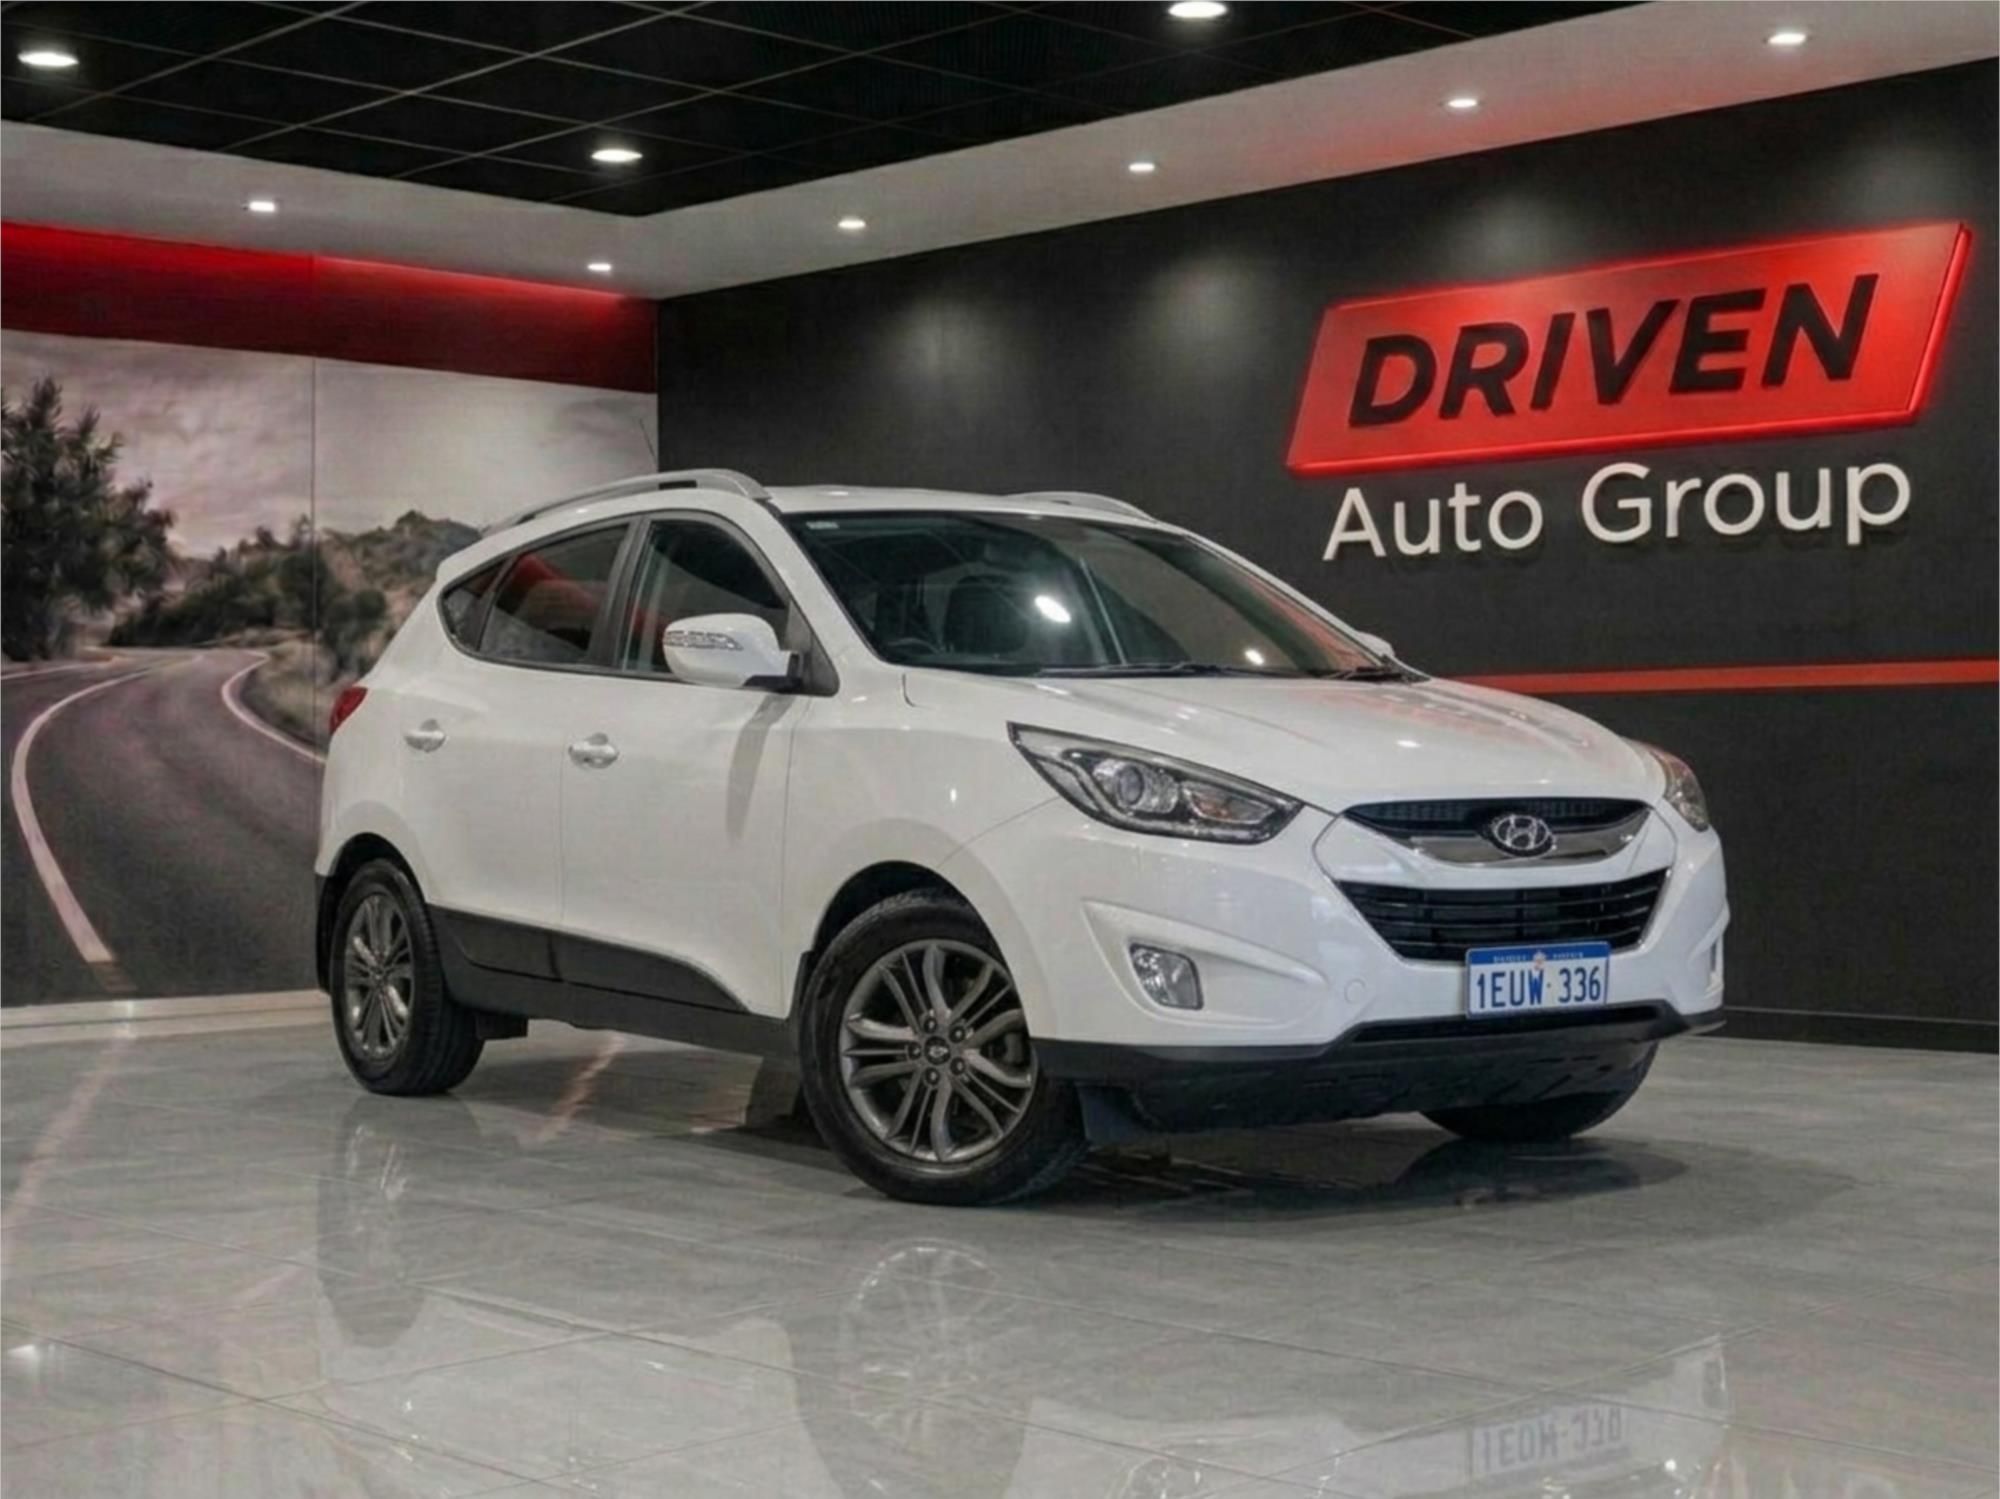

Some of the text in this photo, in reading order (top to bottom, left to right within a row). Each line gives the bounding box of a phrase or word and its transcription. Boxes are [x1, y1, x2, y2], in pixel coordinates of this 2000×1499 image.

[1347, 273, 1879, 428] DRIVEN
[1322, 462, 1911, 561] Auto Group
